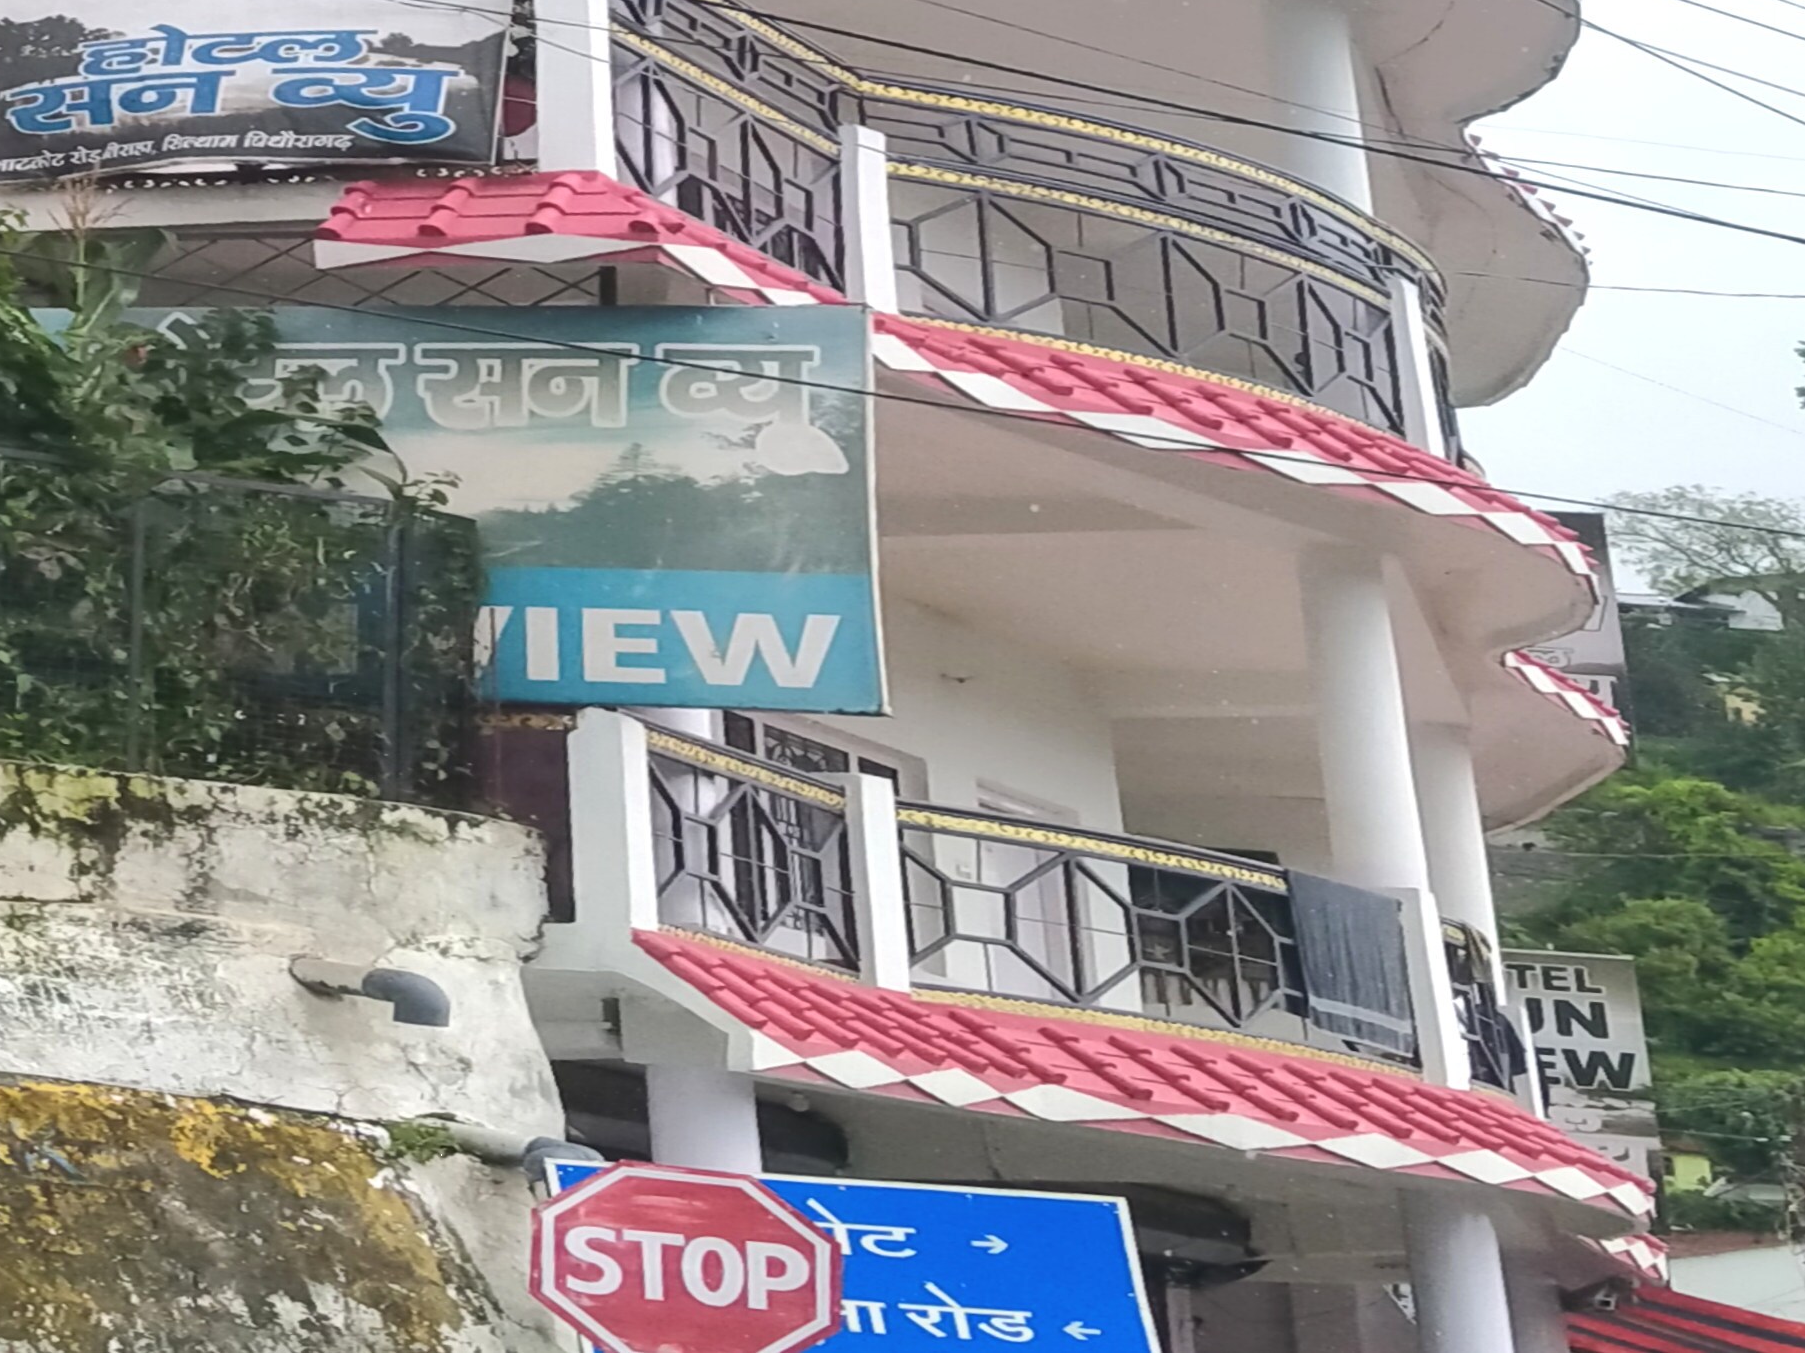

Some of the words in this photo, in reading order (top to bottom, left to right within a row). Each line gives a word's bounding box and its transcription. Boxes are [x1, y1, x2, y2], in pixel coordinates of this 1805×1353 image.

[78, 23, 378, 79] होटल
[4, 69, 235, 135] सन
[414, 342, 638, 428] सन
[1504, 963, 1604, 995] TEL
[1534, 1046, 1637, 1091] EW
[565, 1225, 810, 1310] STOP
[898, 1280, 1035, 1343] रोड
